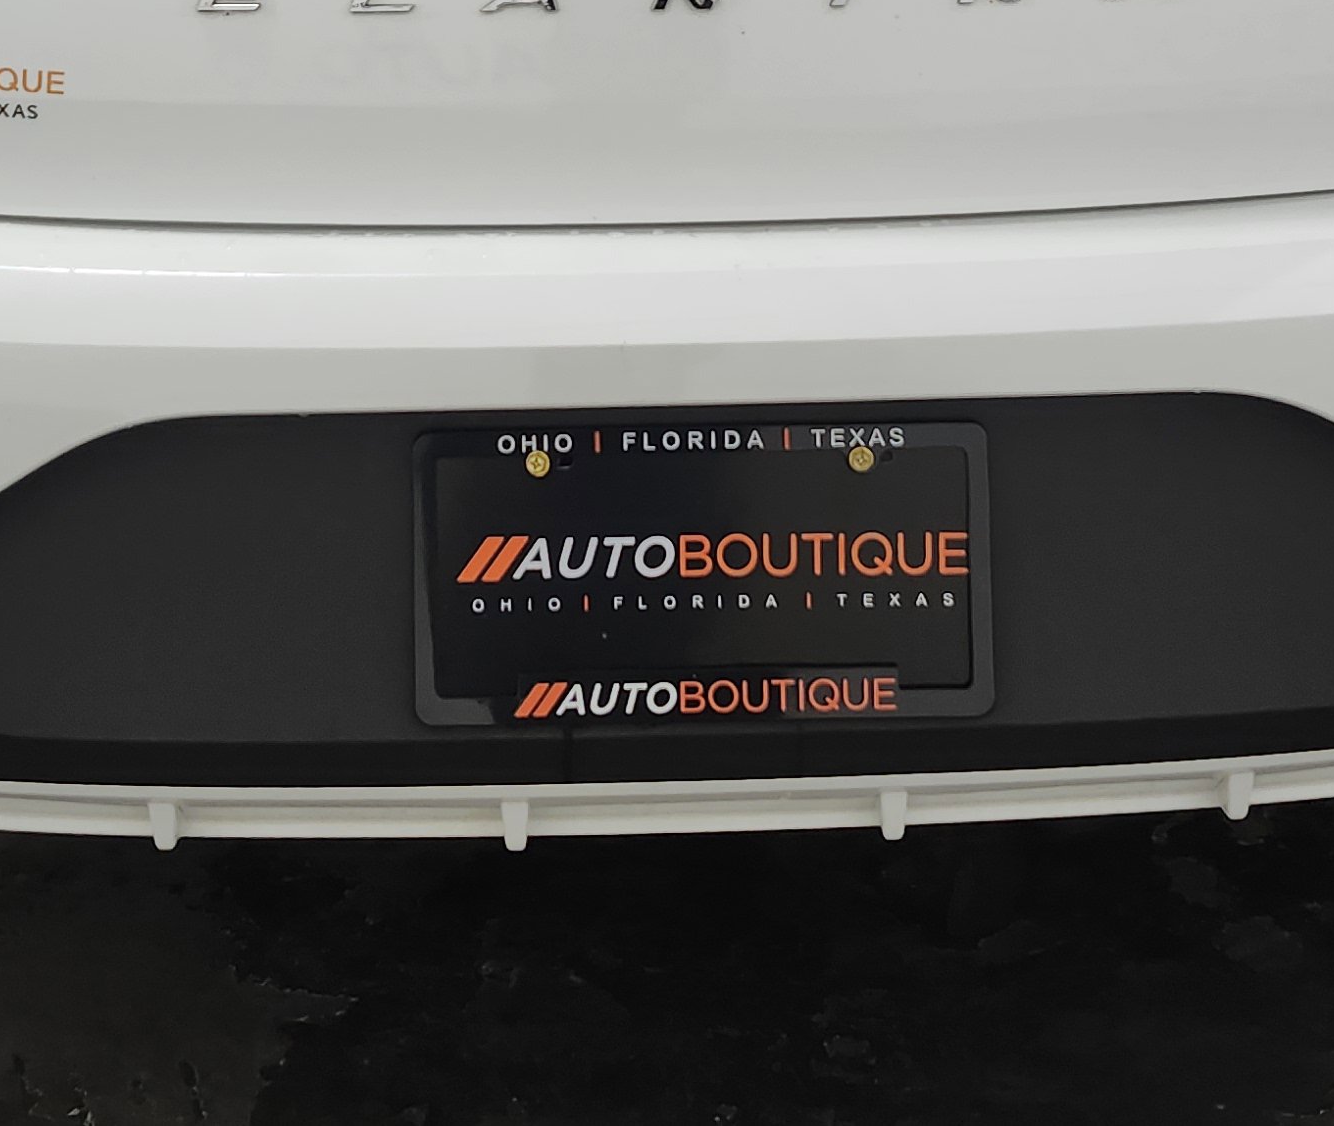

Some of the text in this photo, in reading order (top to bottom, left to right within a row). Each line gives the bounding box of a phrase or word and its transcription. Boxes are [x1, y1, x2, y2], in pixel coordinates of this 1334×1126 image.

[496, 426, 906, 456] OHIO FLORIDA TEXAS
[512, 531, 970, 582] AUTOBOUTIQUE
[471, 591, 957, 614] OHIO FLORIDA TEXAS
[555, 677, 898, 720] AUTOBOUTIQUE
